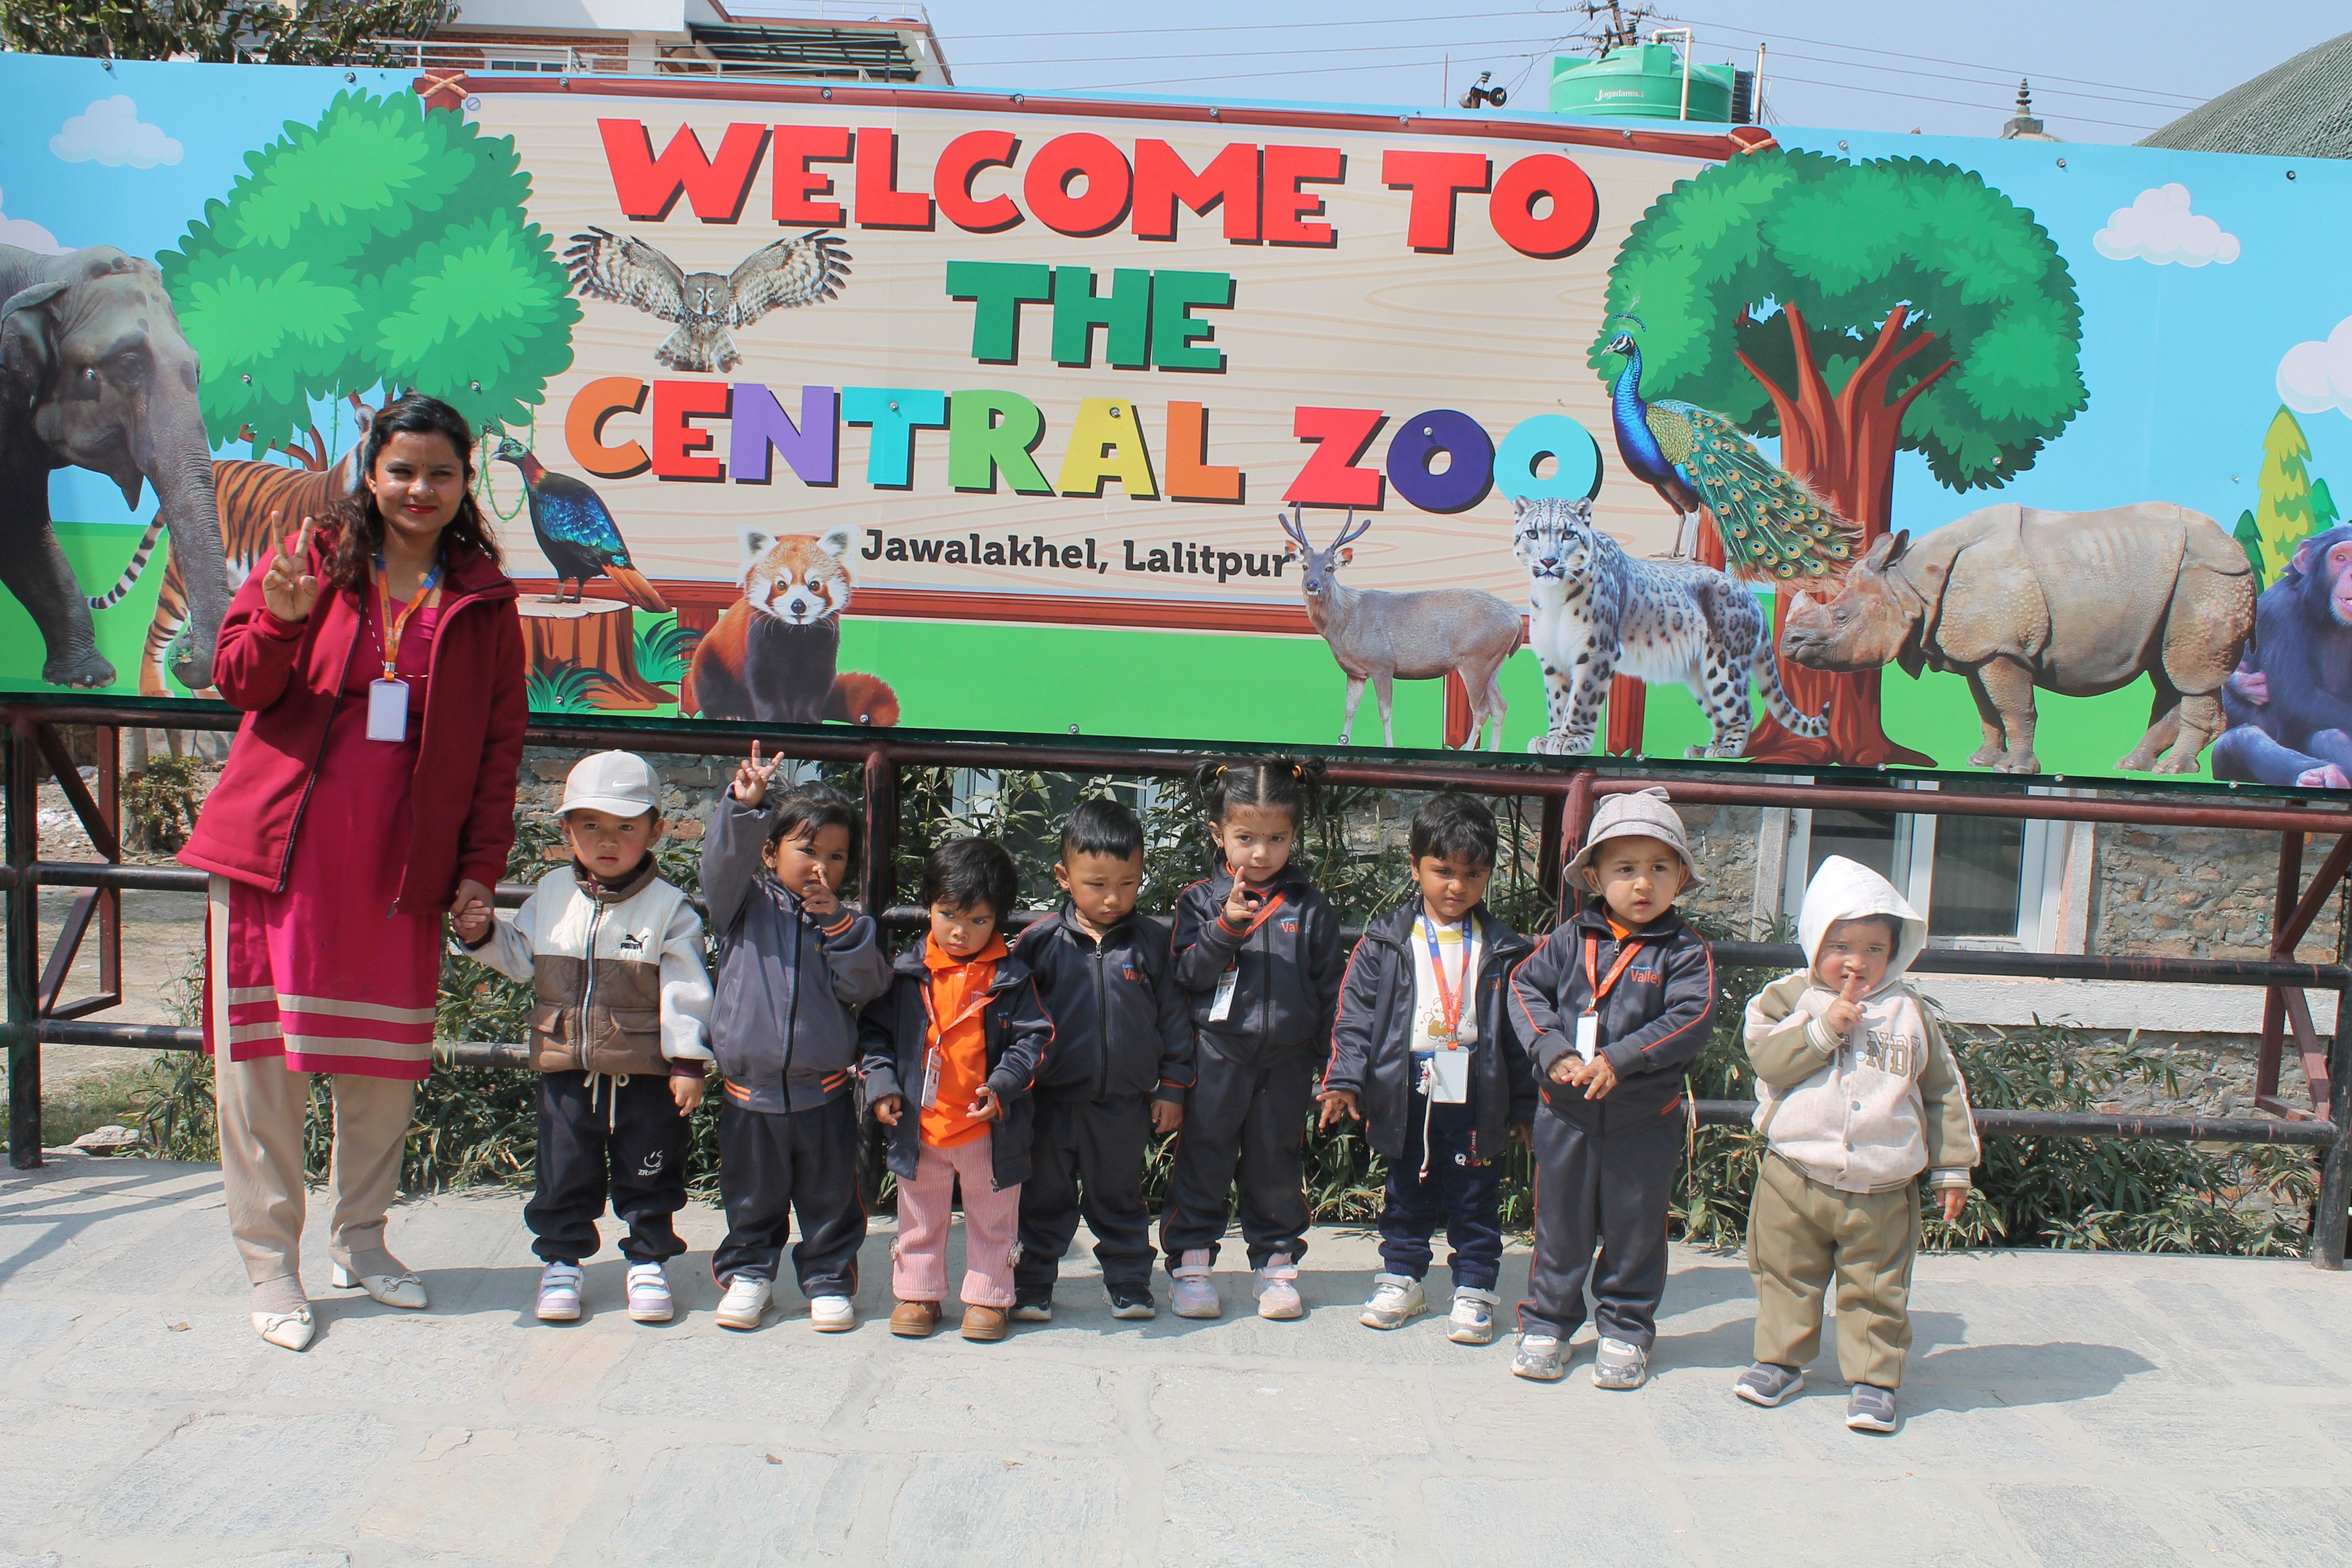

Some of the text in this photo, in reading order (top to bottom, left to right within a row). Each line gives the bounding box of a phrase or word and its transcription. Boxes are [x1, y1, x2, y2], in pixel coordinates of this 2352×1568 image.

[597, 118, 1599, 258] WELCOME TO
[945, 260, 1237, 374] THE
[564, 377, 1603, 512] CENTRAL ZOO
[861, 529, 1292, 583] Jawalakhel, Lalitpur
[1630, 968, 1663, 988] Valley
